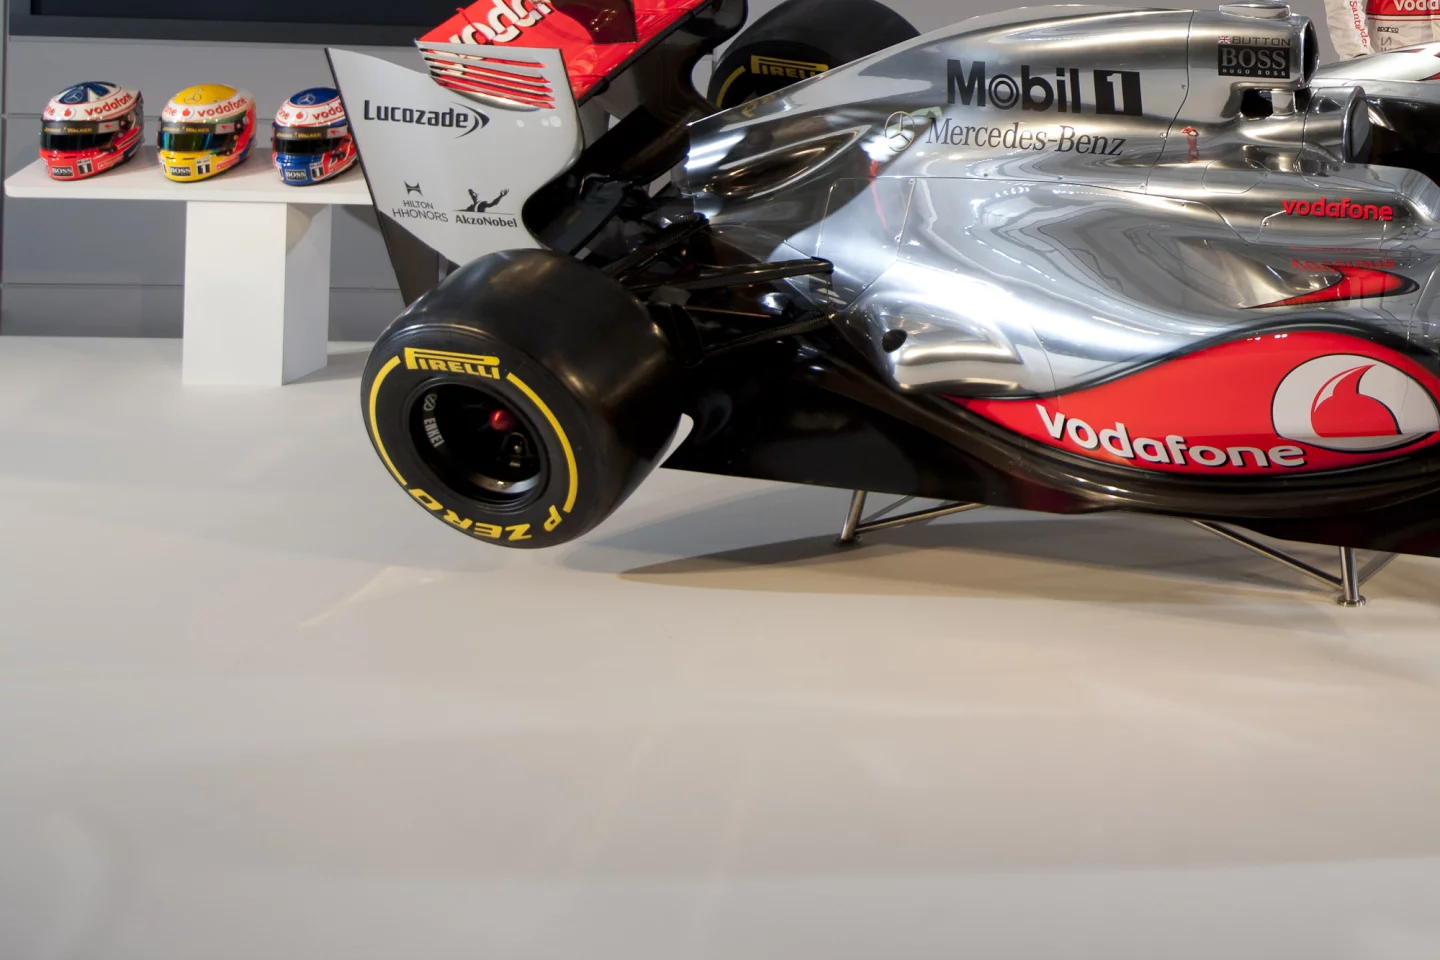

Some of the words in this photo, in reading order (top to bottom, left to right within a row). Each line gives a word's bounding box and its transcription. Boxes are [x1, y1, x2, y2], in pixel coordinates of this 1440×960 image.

[1231, 36, 1291, 46] BUTTON
[751, 54, 829, 78] PIREL
[1221, 47, 1286, 69] BOSS
[947, 59, 1081, 114] Mobil
[1099, 71, 1135, 116] 1
[364, 100, 469, 128] Lucozade
[926, 116, 1126, 157] Mercedes-Benz
[392, 208, 449, 222] HHONORS
[403, 200, 434, 209] HILTON
[1281, 197, 1394, 221] vodafone
[455, 214, 518, 228] AkzoNobel
[404, 347, 500, 379] PIRELLI
[1035, 403, 1308, 469] vodafone
[405, 487, 532, 541] ZERO
[543, 504, 563, 533] P
